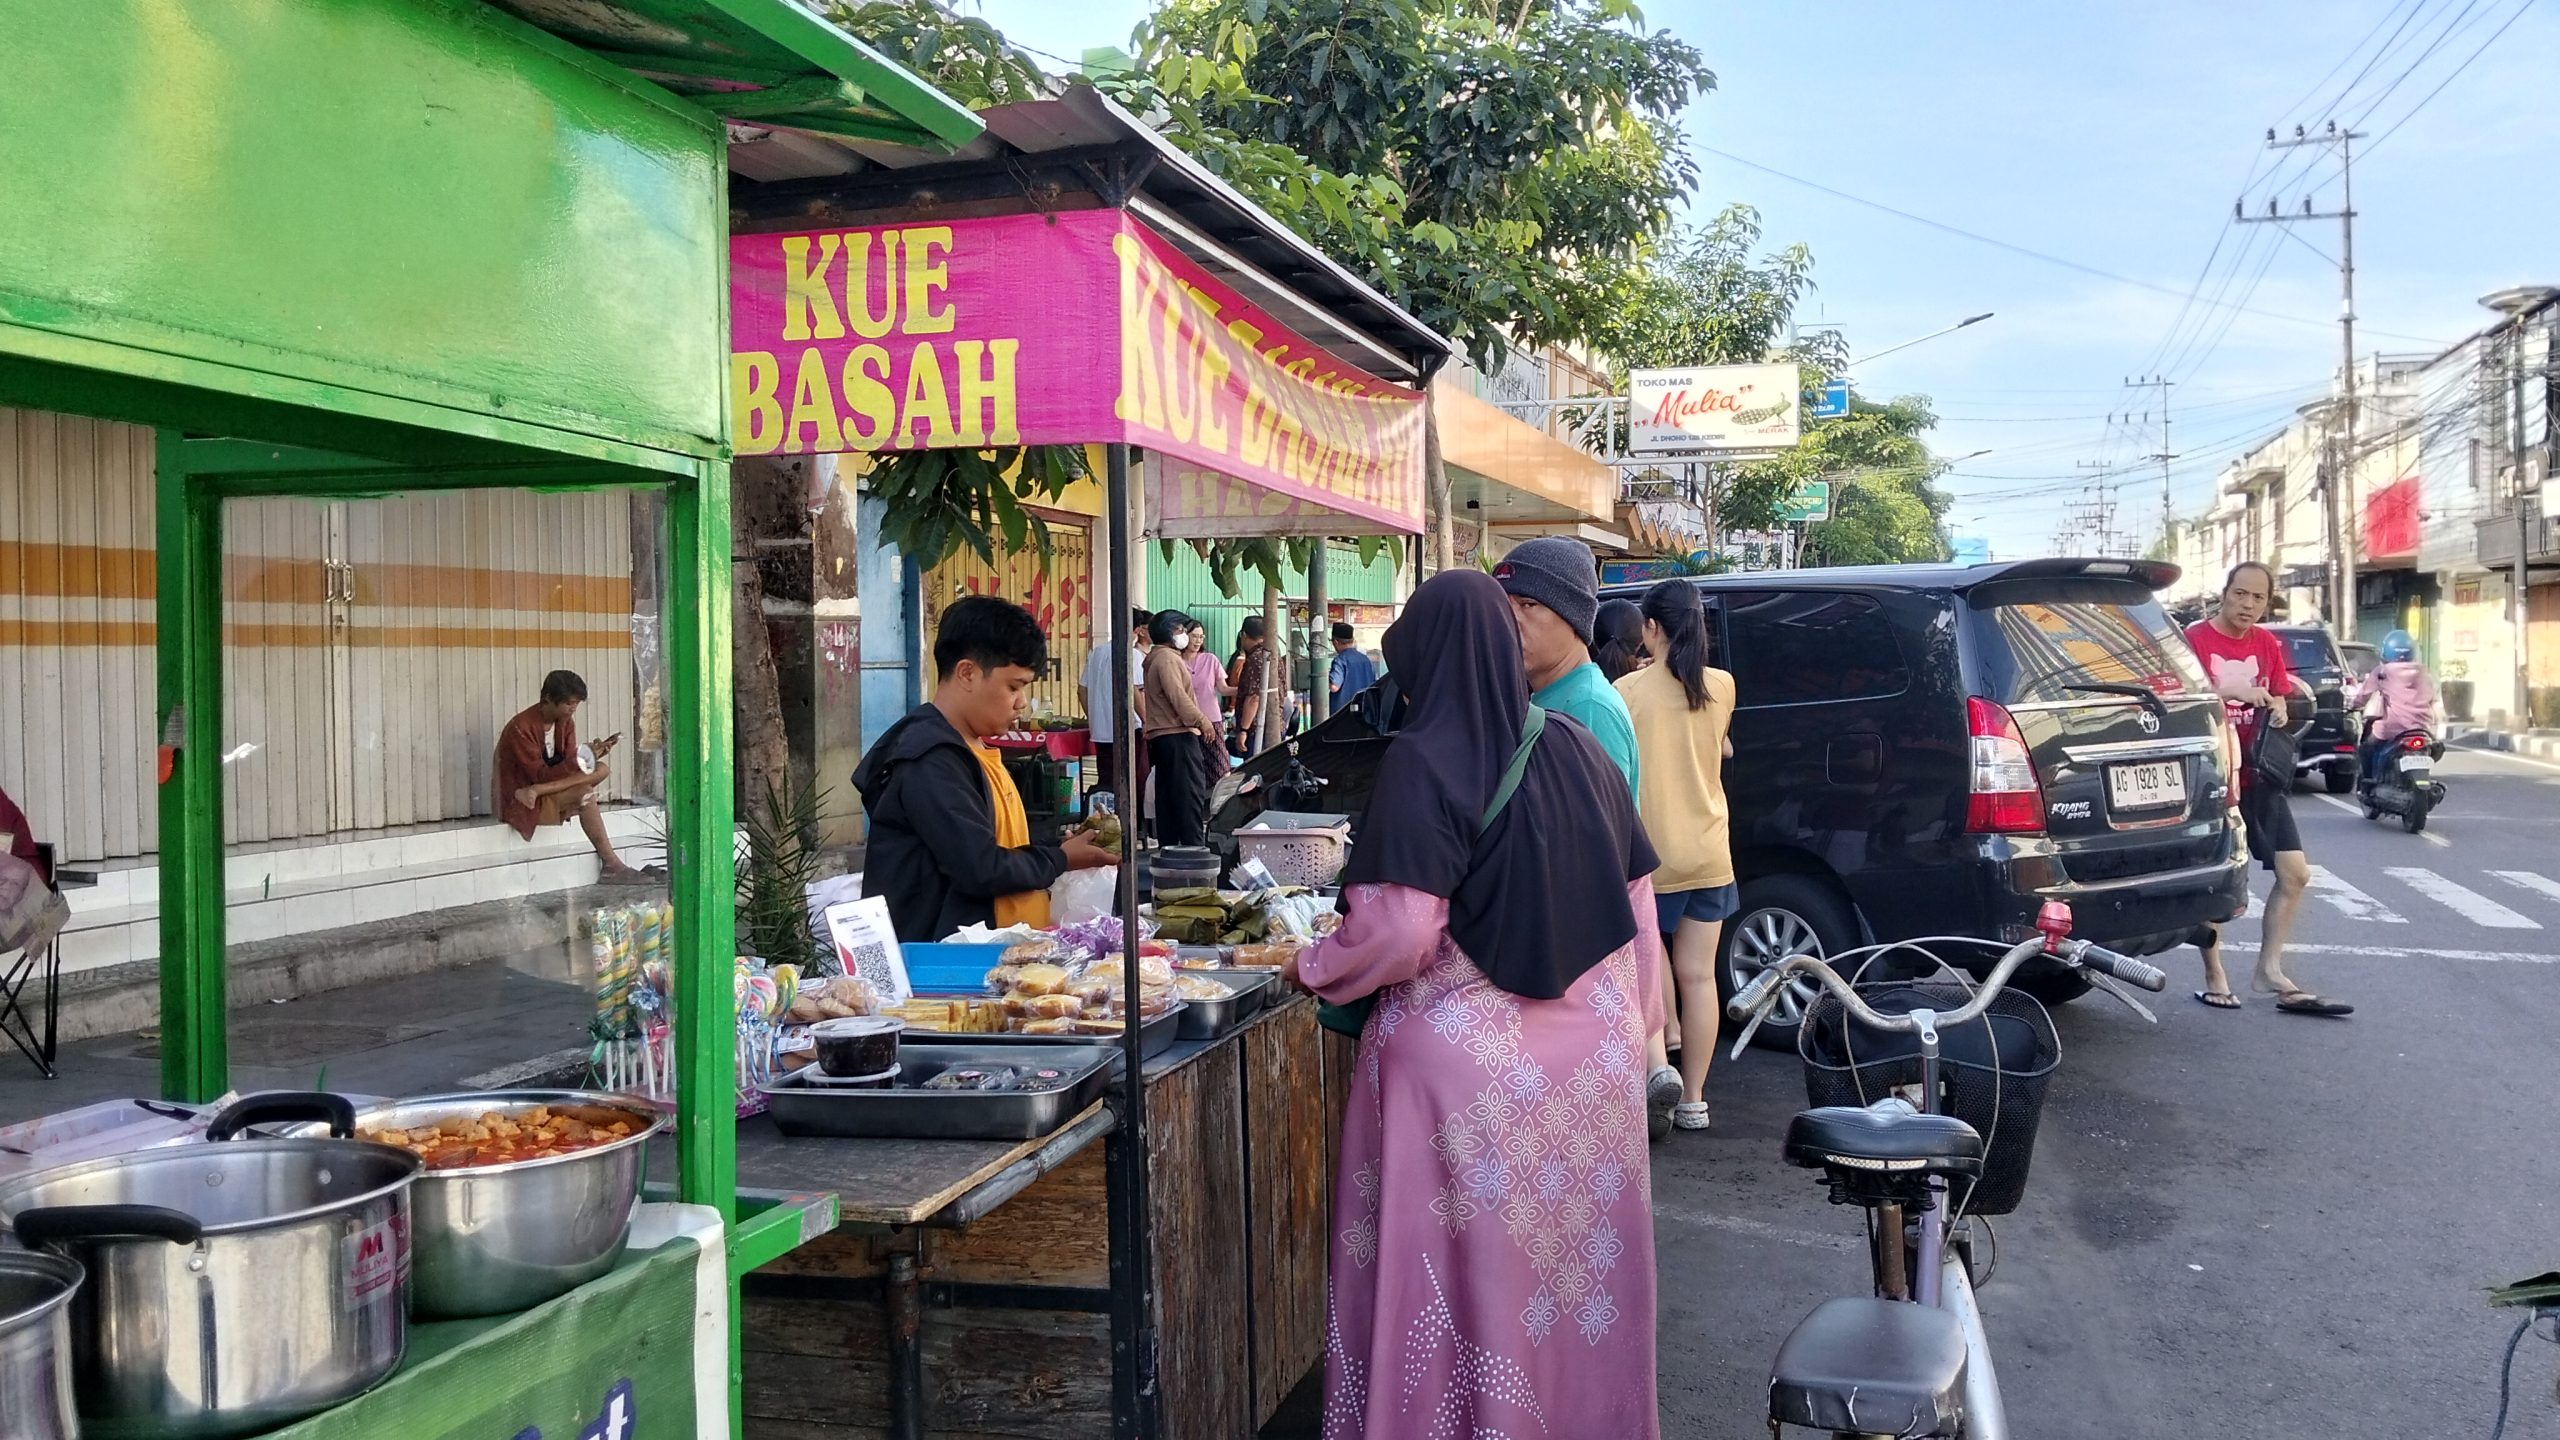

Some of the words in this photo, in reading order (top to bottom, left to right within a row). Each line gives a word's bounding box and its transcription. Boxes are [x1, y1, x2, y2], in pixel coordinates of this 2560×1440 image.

[782, 226, 955, 340] KUE
[1113, 233, 1231, 454] KUE
[731, 338, 1021, 454] BASAH
[1637, 379, 1667, 387] TOKO
[1669, 378, 1693, 386] MAS
[2051, 801, 2090, 815] KIJANG
[2116, 769, 2128, 793] AG
[2134, 767, 2159, 791] 1928
[2164, 765, 2180, 787] SL
